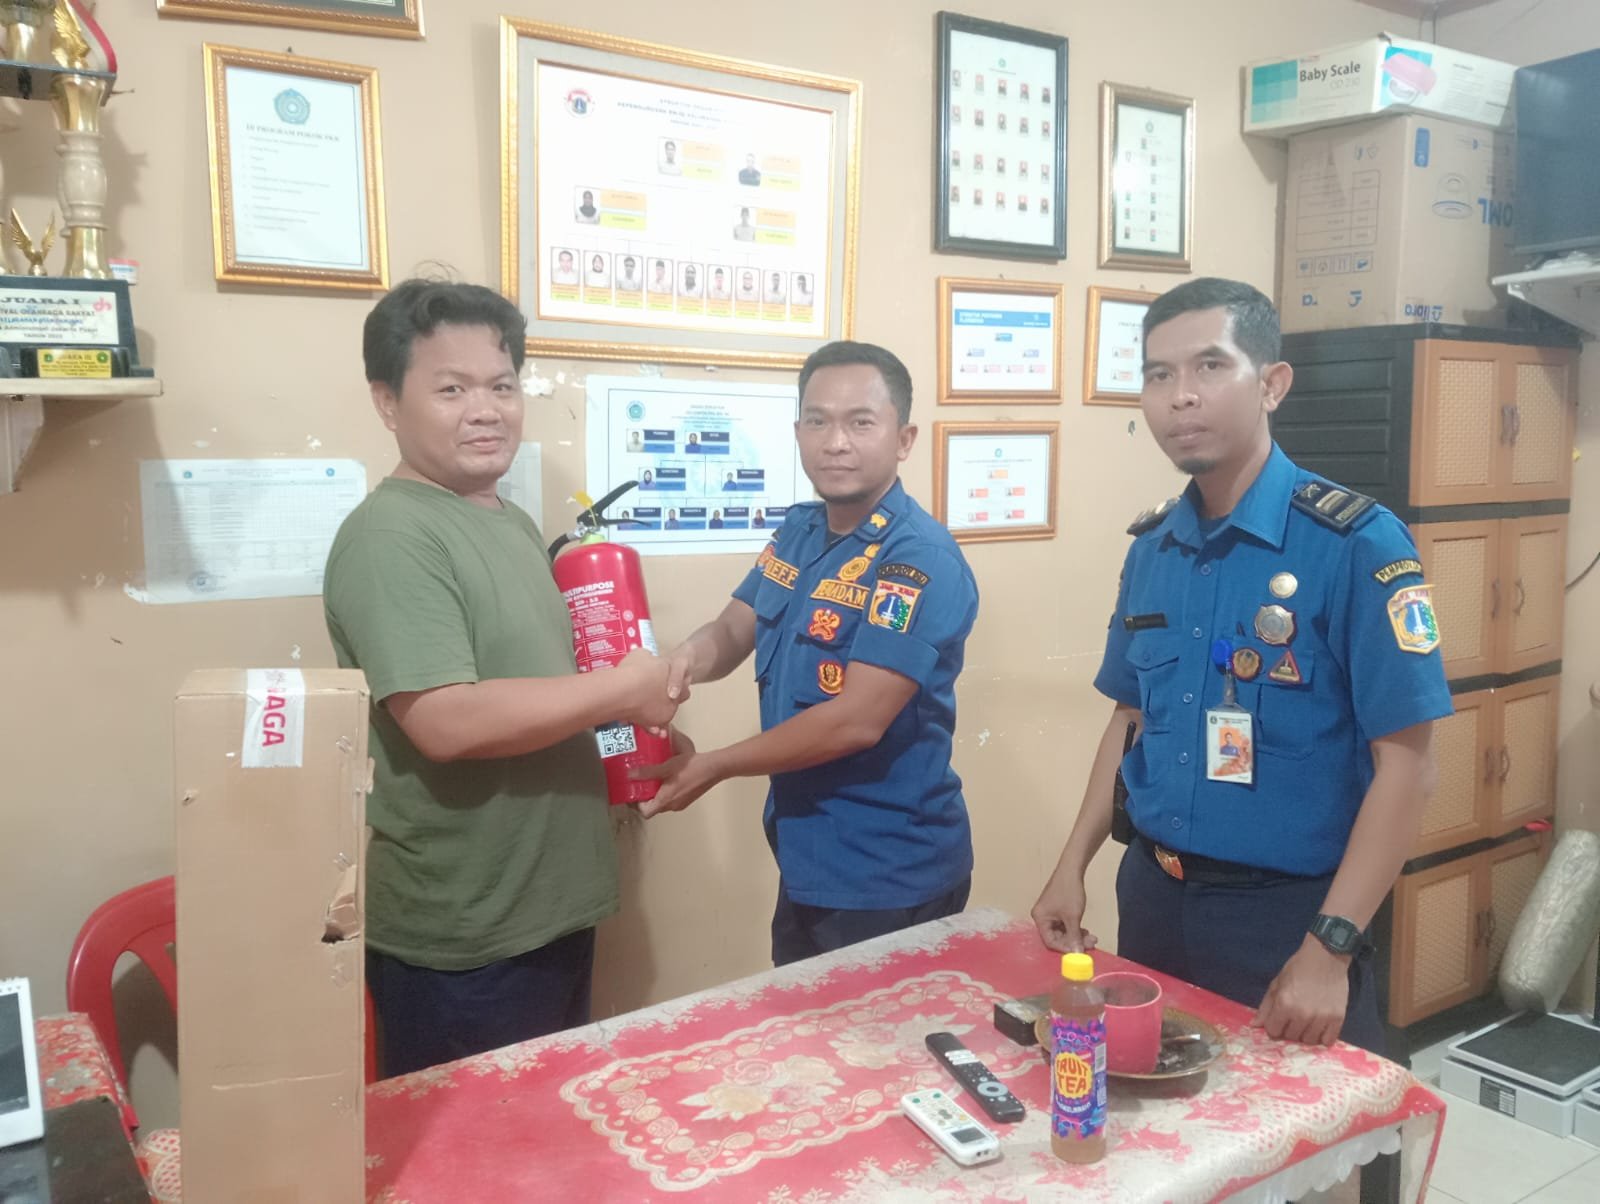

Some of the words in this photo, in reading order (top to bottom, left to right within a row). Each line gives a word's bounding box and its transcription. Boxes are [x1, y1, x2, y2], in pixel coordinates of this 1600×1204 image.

[1299, 67, 1329, 82] Baby
[1330, 60, 1361, 77] Scale
[0, 297, 69, 305] JUARA
[1056, 1057, 1088, 1077] FRUIT
[1057, 1075, 1087, 1094] TEA
